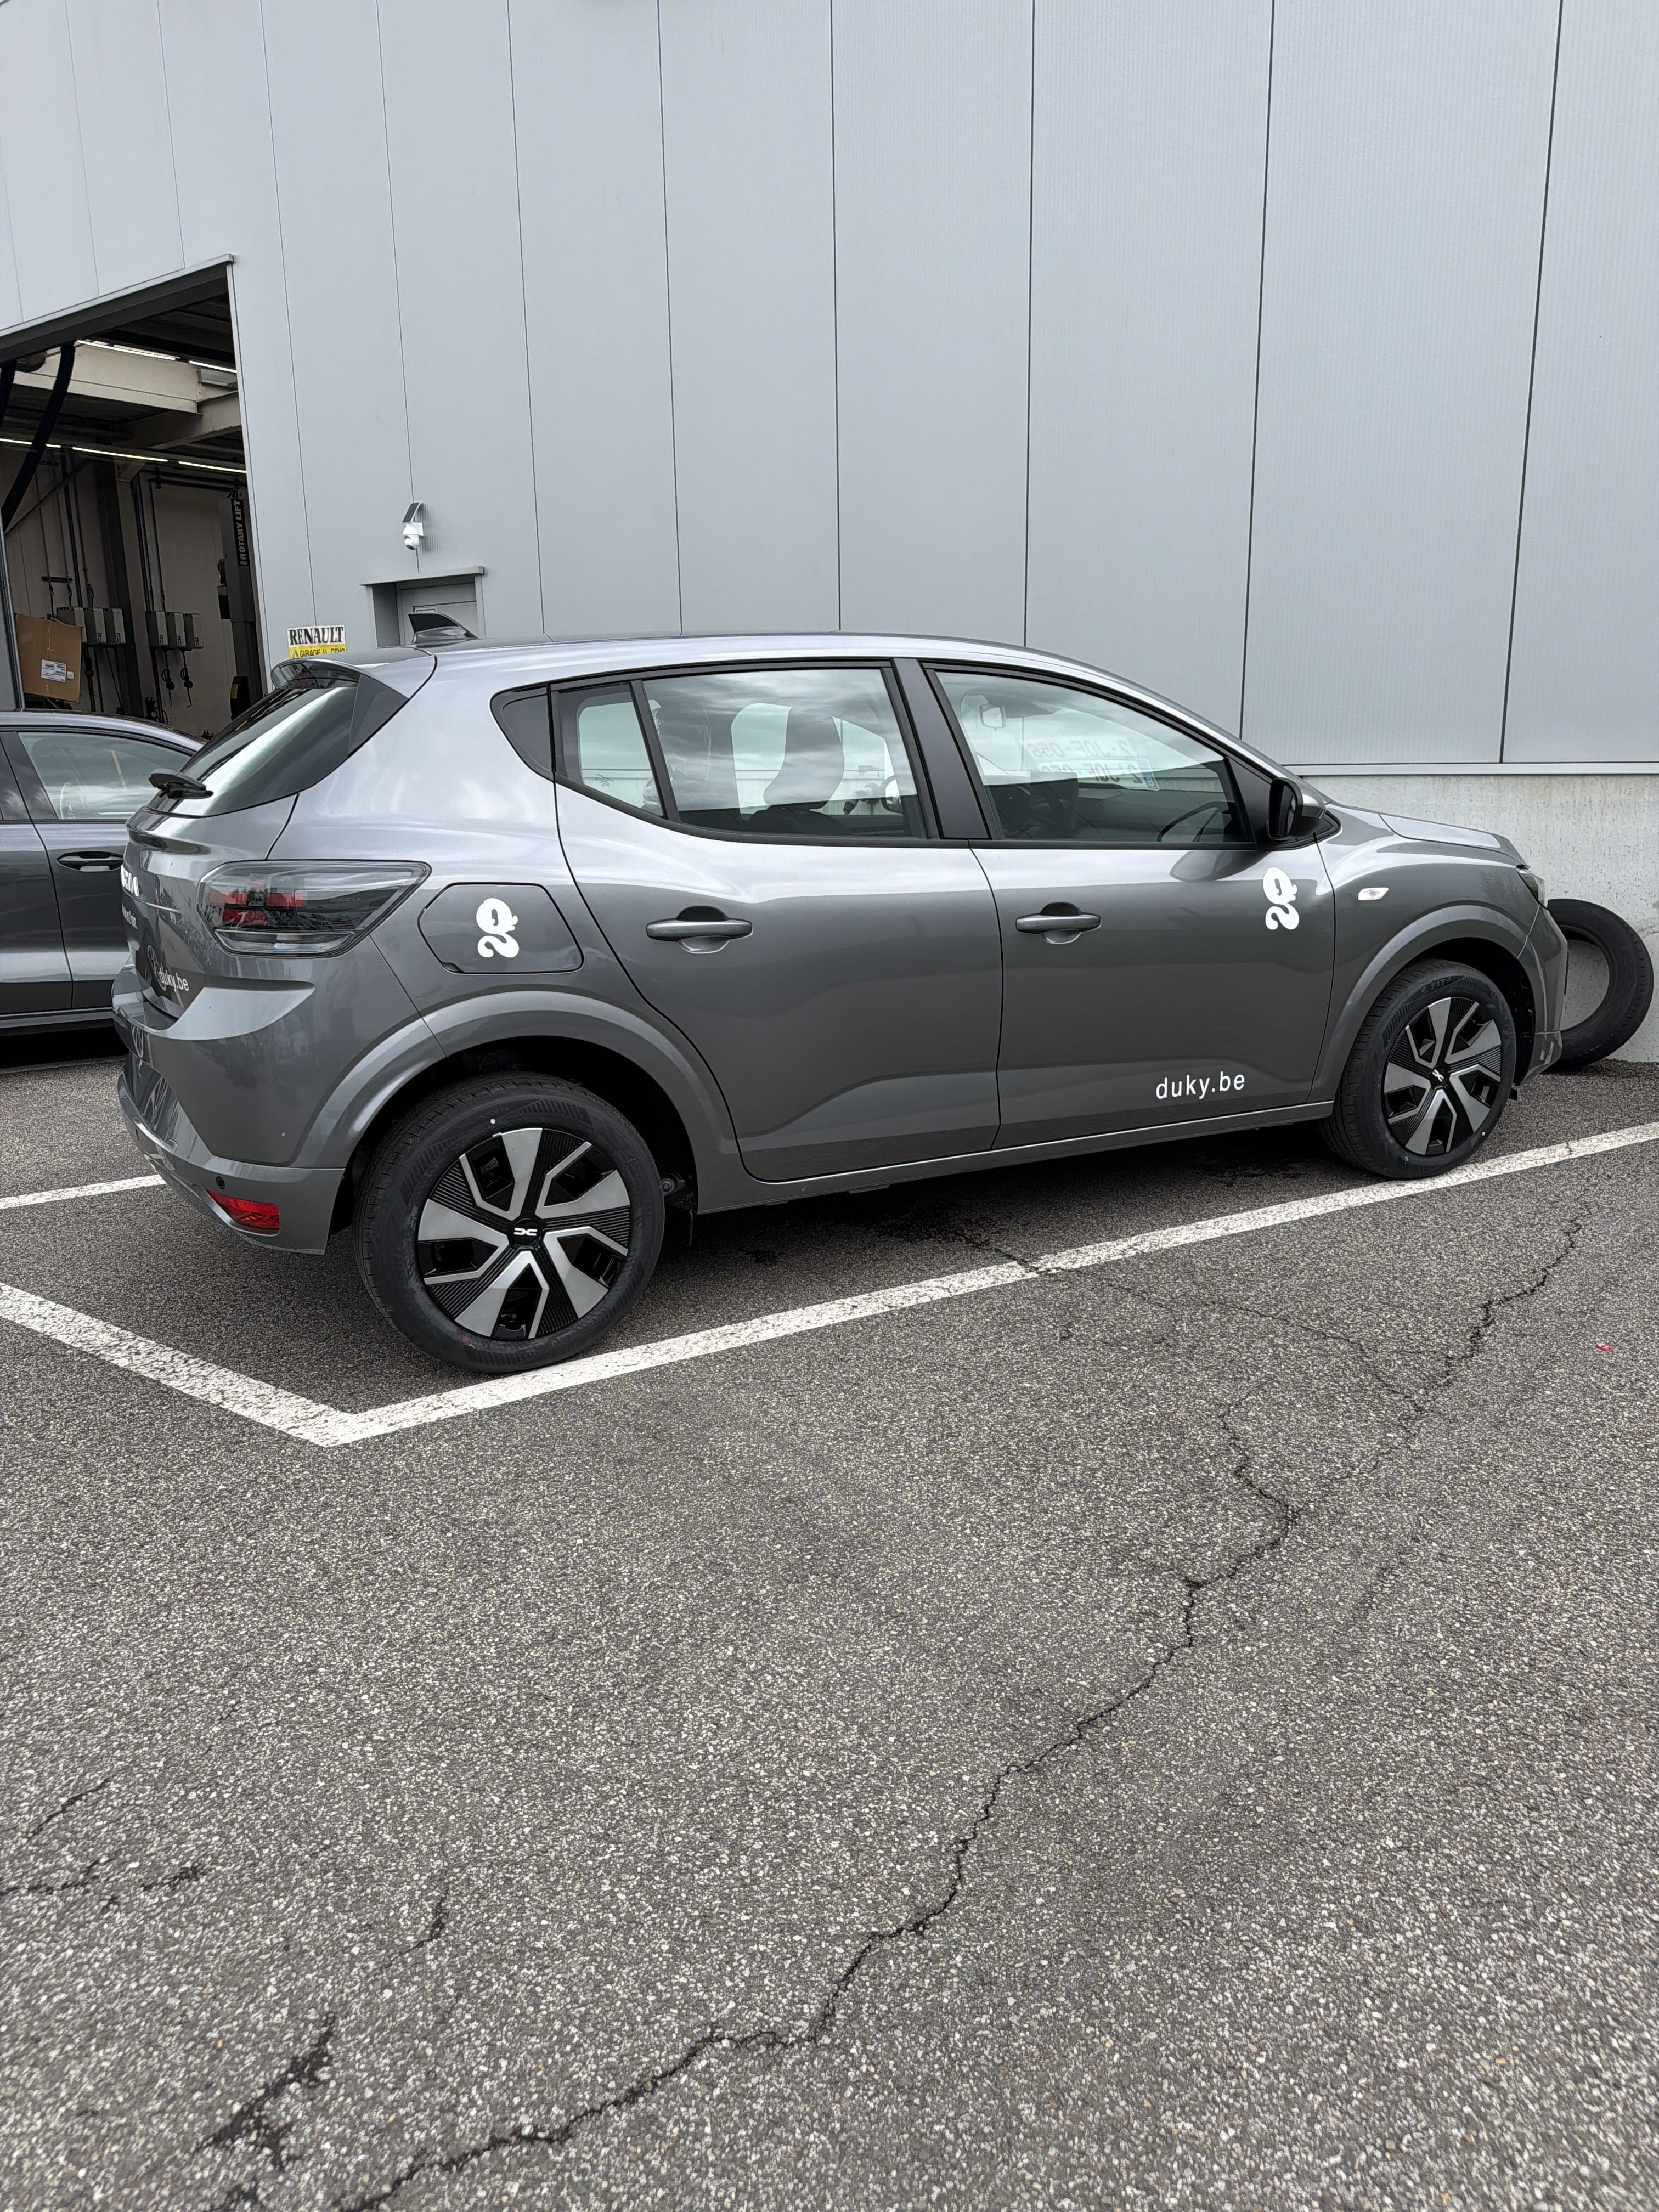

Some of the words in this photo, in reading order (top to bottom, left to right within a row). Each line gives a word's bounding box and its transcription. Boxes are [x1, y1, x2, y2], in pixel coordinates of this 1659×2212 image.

[236, 522, 246, 560] ROTARY
[289, 627, 343, 645] RENAULT
[159, 967, 189, 992] duky.be
[1156, 1071, 1245, 1099] duky.be
